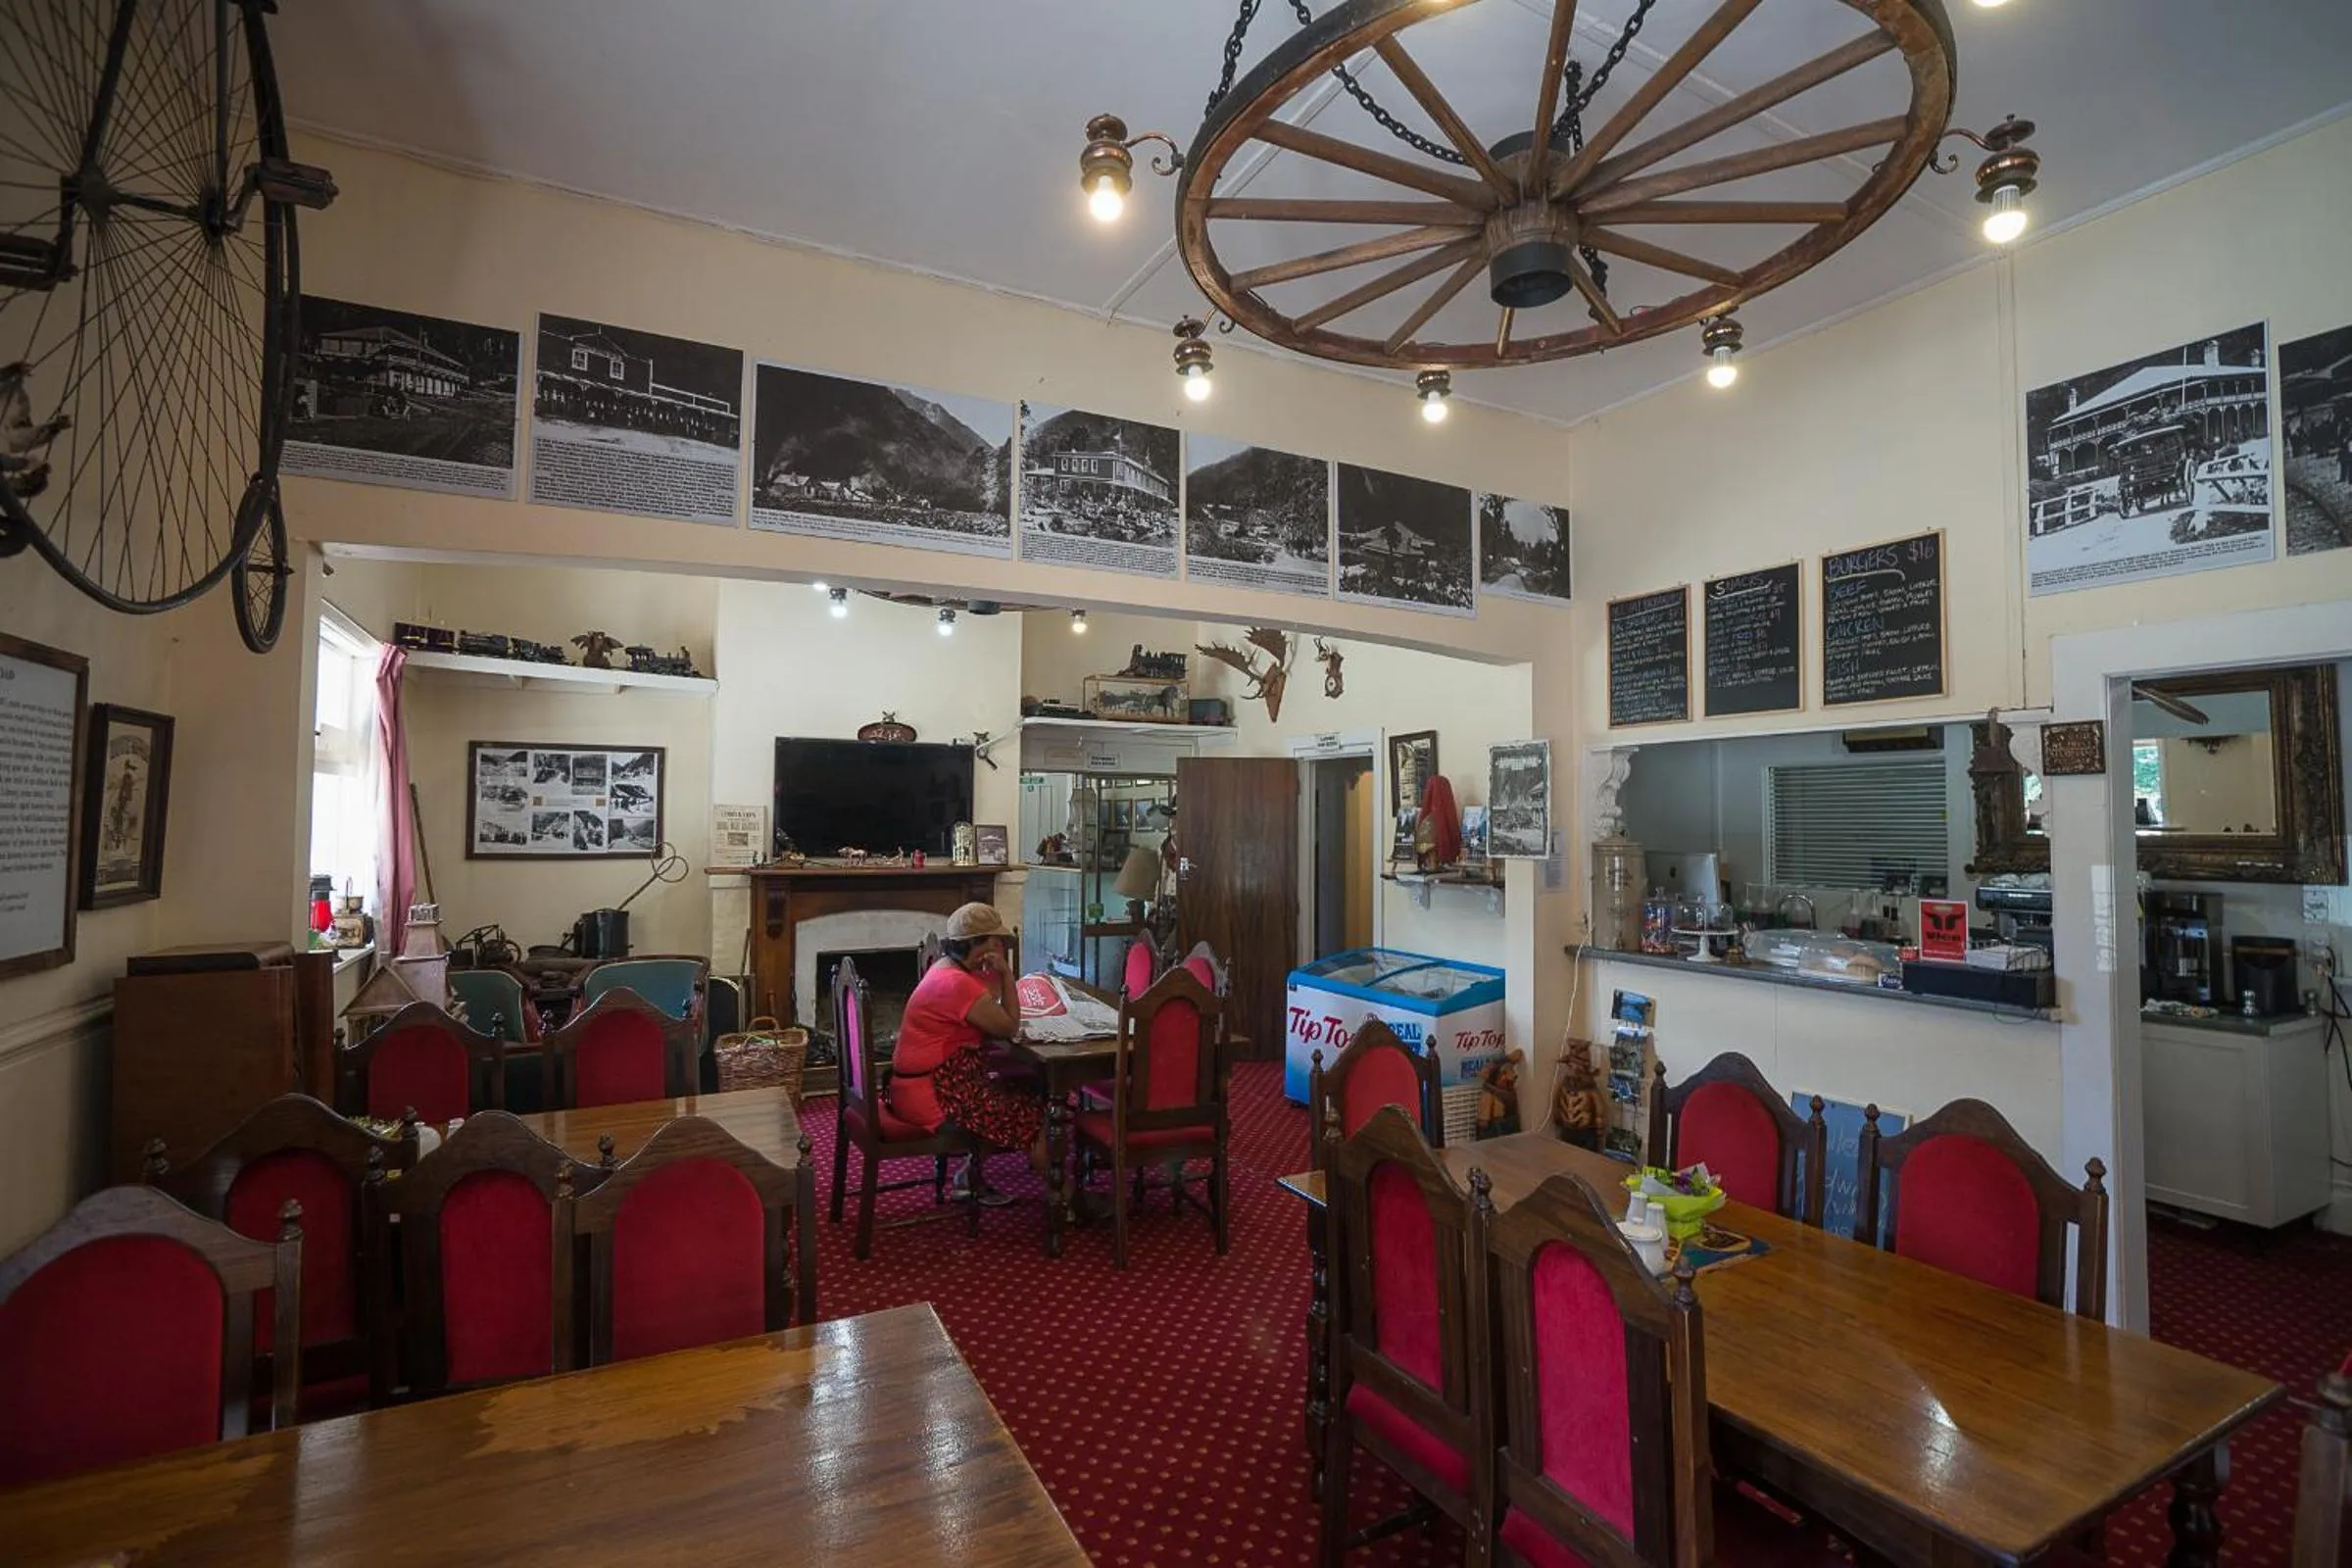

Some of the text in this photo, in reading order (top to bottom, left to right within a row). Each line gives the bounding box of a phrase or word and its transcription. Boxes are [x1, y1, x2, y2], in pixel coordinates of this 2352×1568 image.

[1828, 546, 1898, 576] BURGERS
[1830, 579, 1868, 601] BEEF
[1827, 617, 1886, 640] CHICKEN
[1289, 1006, 1354, 1049] Tip To
[1455, 1031, 1479, 1052] Tip
